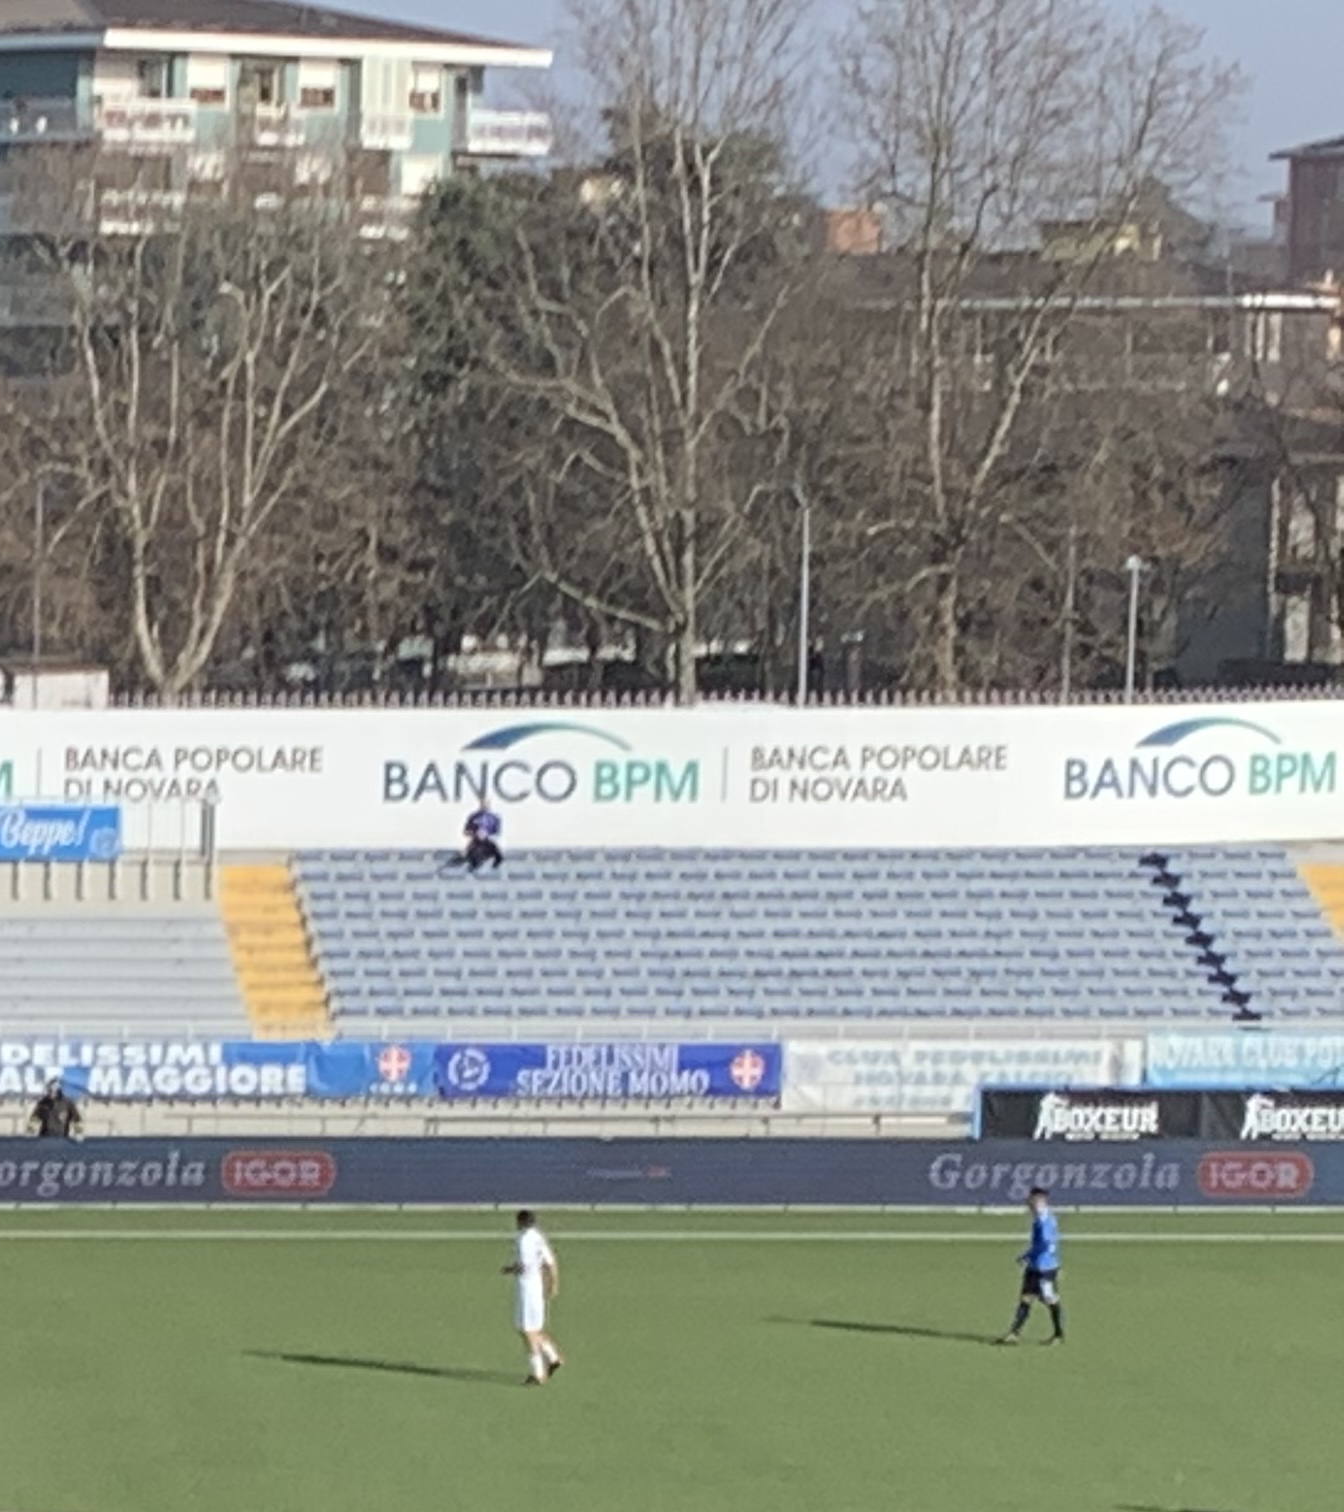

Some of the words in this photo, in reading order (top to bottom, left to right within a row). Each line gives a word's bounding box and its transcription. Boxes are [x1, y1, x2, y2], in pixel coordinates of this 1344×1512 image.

[65, 746, 162, 772] BANCA
[173, 746, 323, 773] POPOLARE
[751, 746, 850, 771] BANCA
[861, 745, 1008, 771] POPOLARE
[64, 778, 92, 801] DI
[103, 778, 221, 802] NOVARA
[382, 760, 577, 803] BANCO
[593, 760, 698, 803] BPM
[749, 777, 778, 802] DI
[789, 777, 907, 801] NOVARA
[1064, 755, 1235, 800] BANCO
[1248, 751, 1336, 795] BPM
[546, 1044, 679, 1069] FEDELISSIMI
[88, 1065, 307, 1096] MAGGIORE
[516, 1068, 624, 1097] SEZIONE
[628, 1069, 710, 1097] MOMO
[1055, 1101, 1159, 1133] BOXEUR
[233, 1158, 322, 1188] IGOR
[929, 1152, 1180, 1198] Gorgonzola
[1209, 1160, 1300, 1189] IGOR
